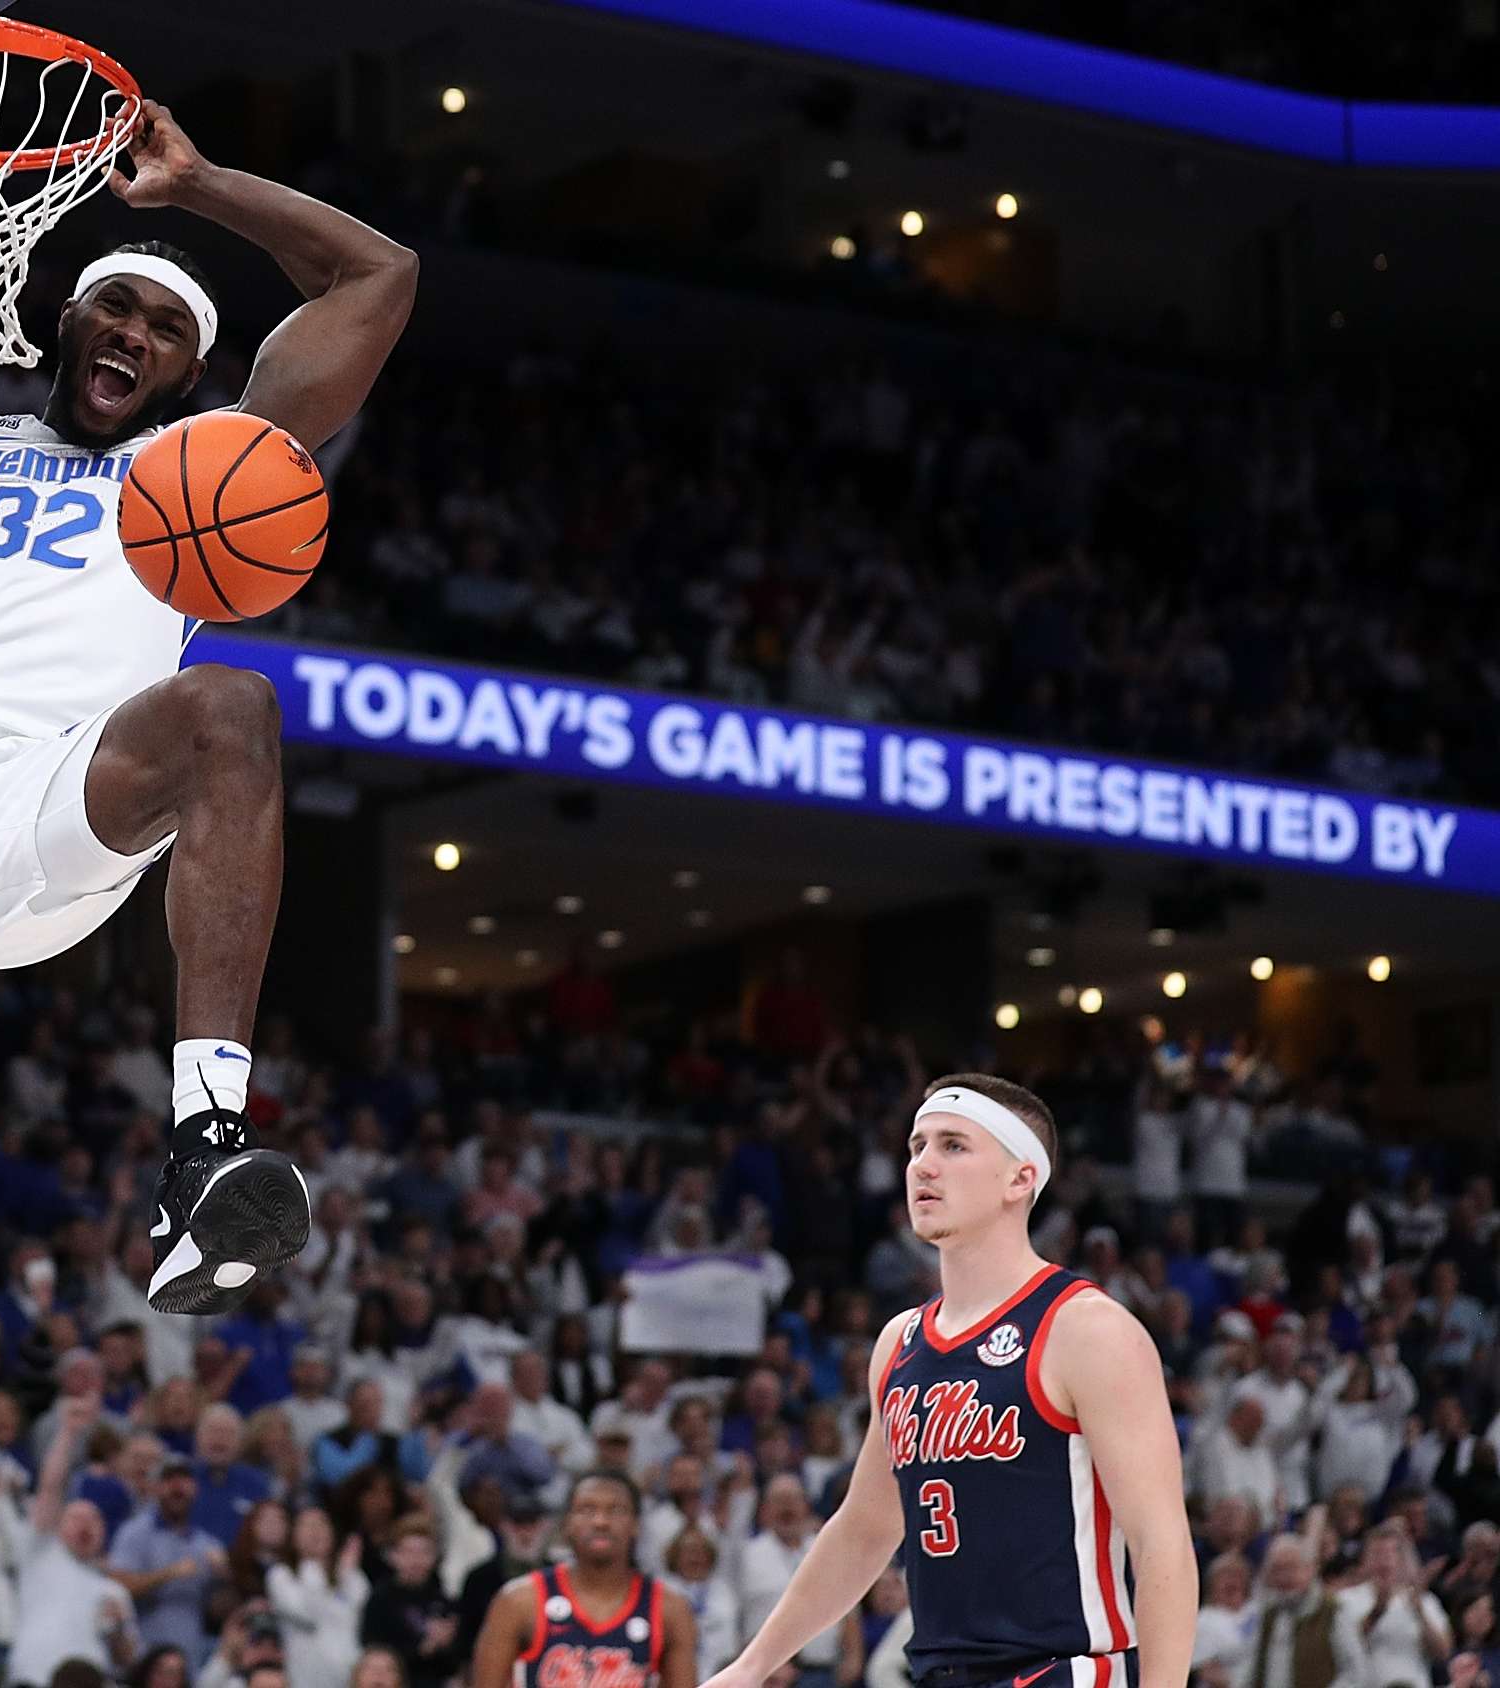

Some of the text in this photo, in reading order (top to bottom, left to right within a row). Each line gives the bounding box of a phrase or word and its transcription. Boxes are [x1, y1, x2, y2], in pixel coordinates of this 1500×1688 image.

[293, 655, 1457, 877] TODAY'S GAME IS PRESENTED BY
[883, 1379, 1026, 1470] Ole Miss
[919, 1479, 959, 1557] 3
